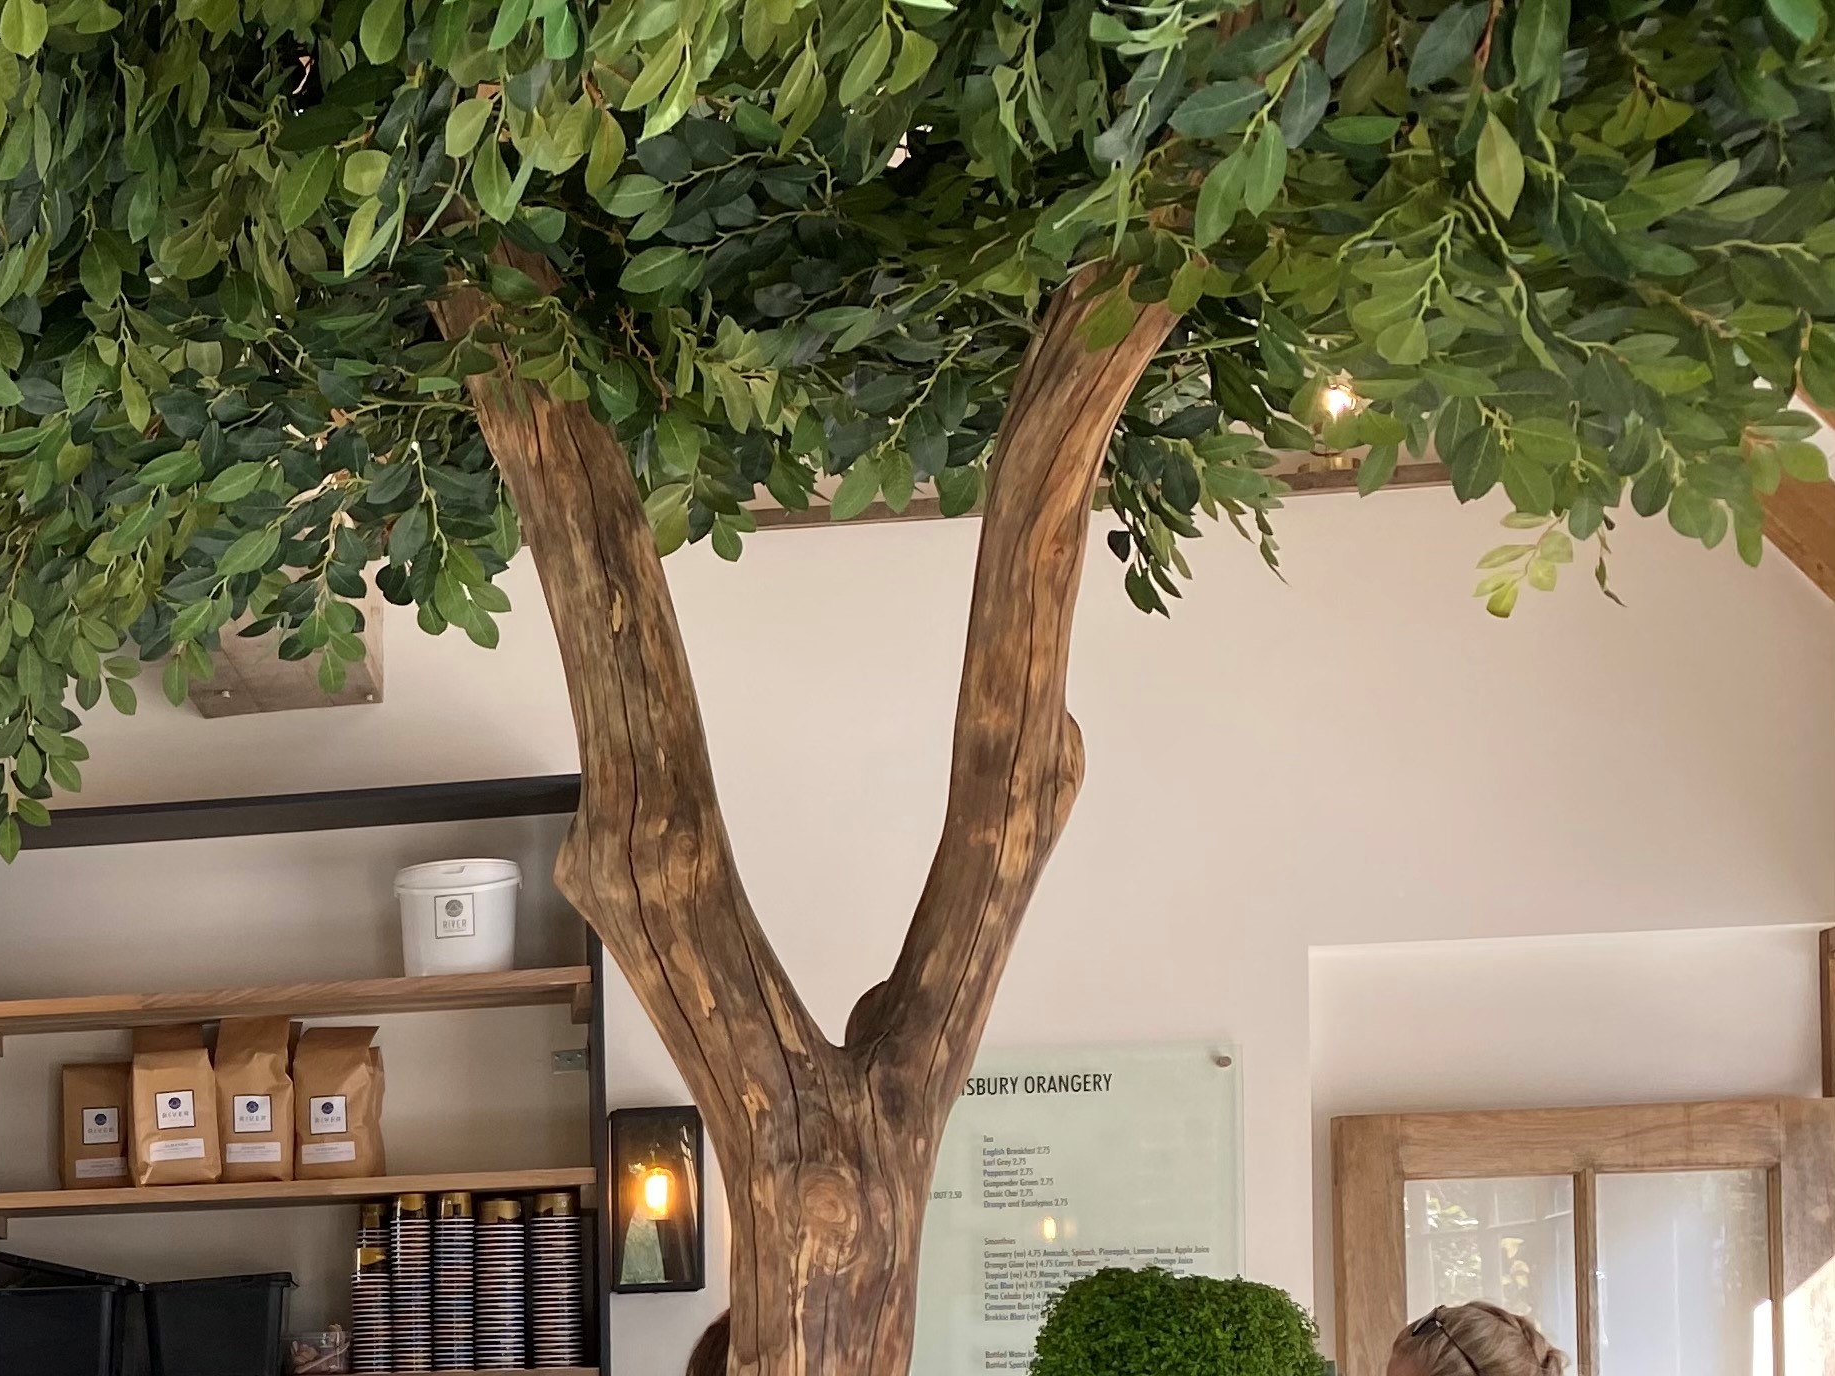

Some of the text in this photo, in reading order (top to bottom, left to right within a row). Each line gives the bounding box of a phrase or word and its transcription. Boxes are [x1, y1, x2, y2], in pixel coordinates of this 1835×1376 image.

[443, 919, 467, 929] RIVER
[1024, 1073, 1113, 1094] ORANGERY
[1013, 1158, 1027, 1166] 2.75
[1020, 1168, 1034, 1176] 2.75
[1040, 1178, 1054, 1186] 2.75
[1019, 1189, 1034, 1197] 2.75
[1028, 1249, 1042, 1257] 4.75
[1040, 1260, 1054, 1268] 4.75
[1024, 1270, 1038, 1278] 4.75
